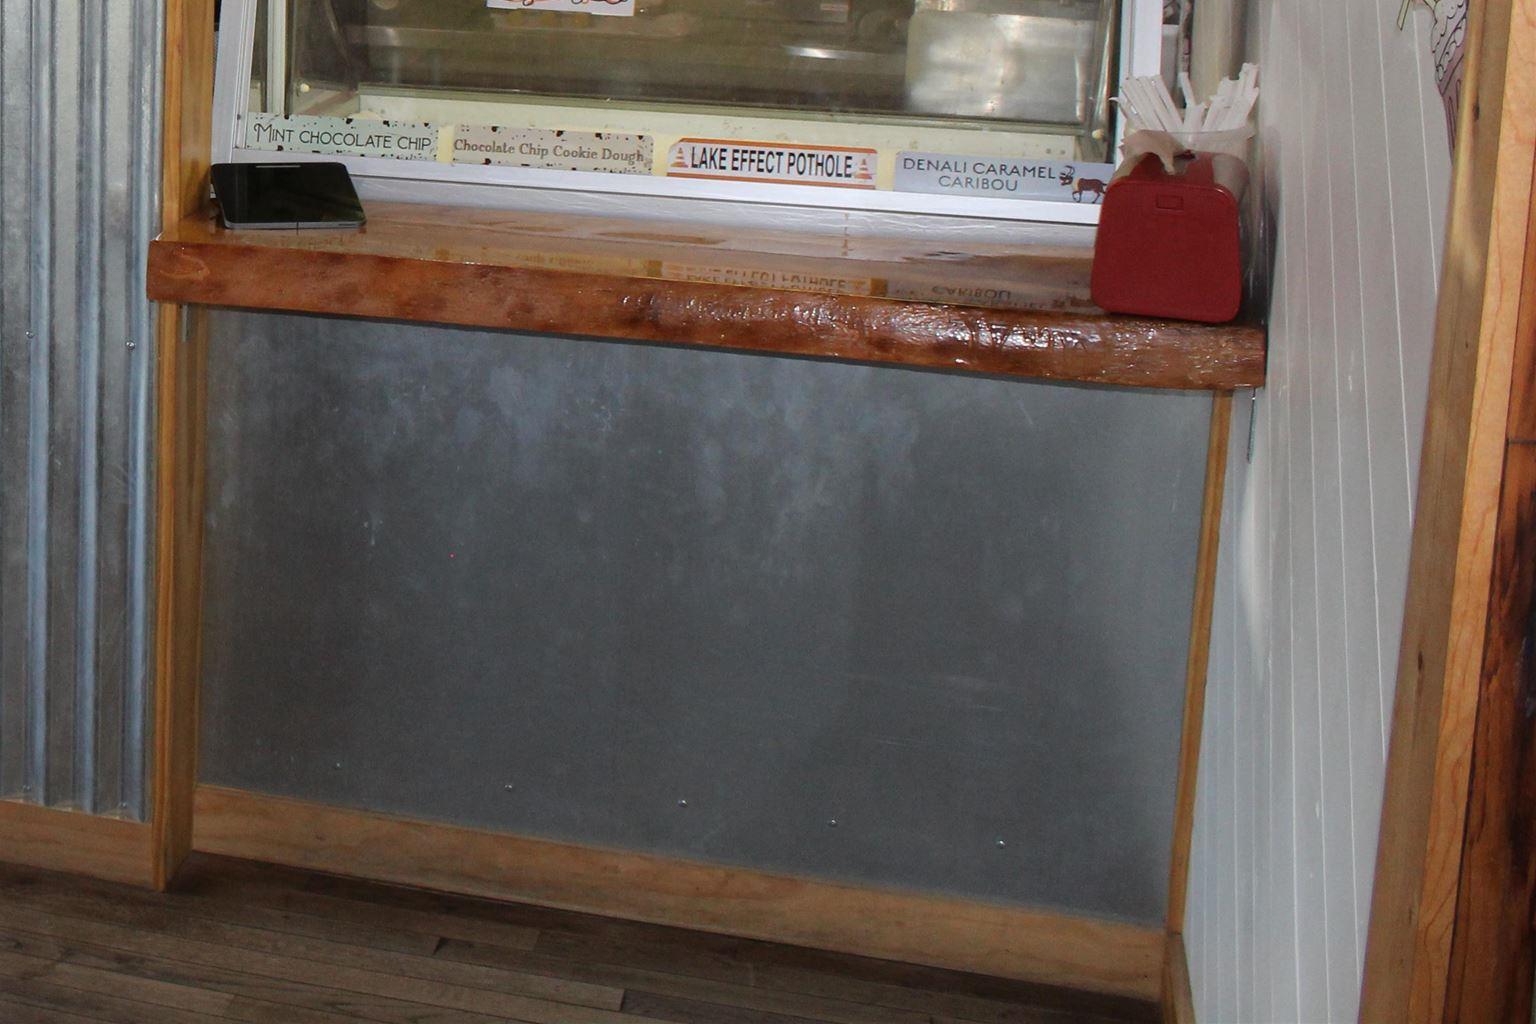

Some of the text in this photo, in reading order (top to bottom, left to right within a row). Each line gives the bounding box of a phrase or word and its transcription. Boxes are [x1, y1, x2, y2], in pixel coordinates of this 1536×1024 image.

[254, 123, 432, 151] MINT CHOCOLATE CHIP
[454, 138, 644, 165] Chocolate Chip Cookie Dough
[691, 146, 853, 178] LAKE EFFECT POTHOLE
[903, 157, 1056, 180] DENALI CARAMEL
[938, 175, 1018, 192] CARIBOU
